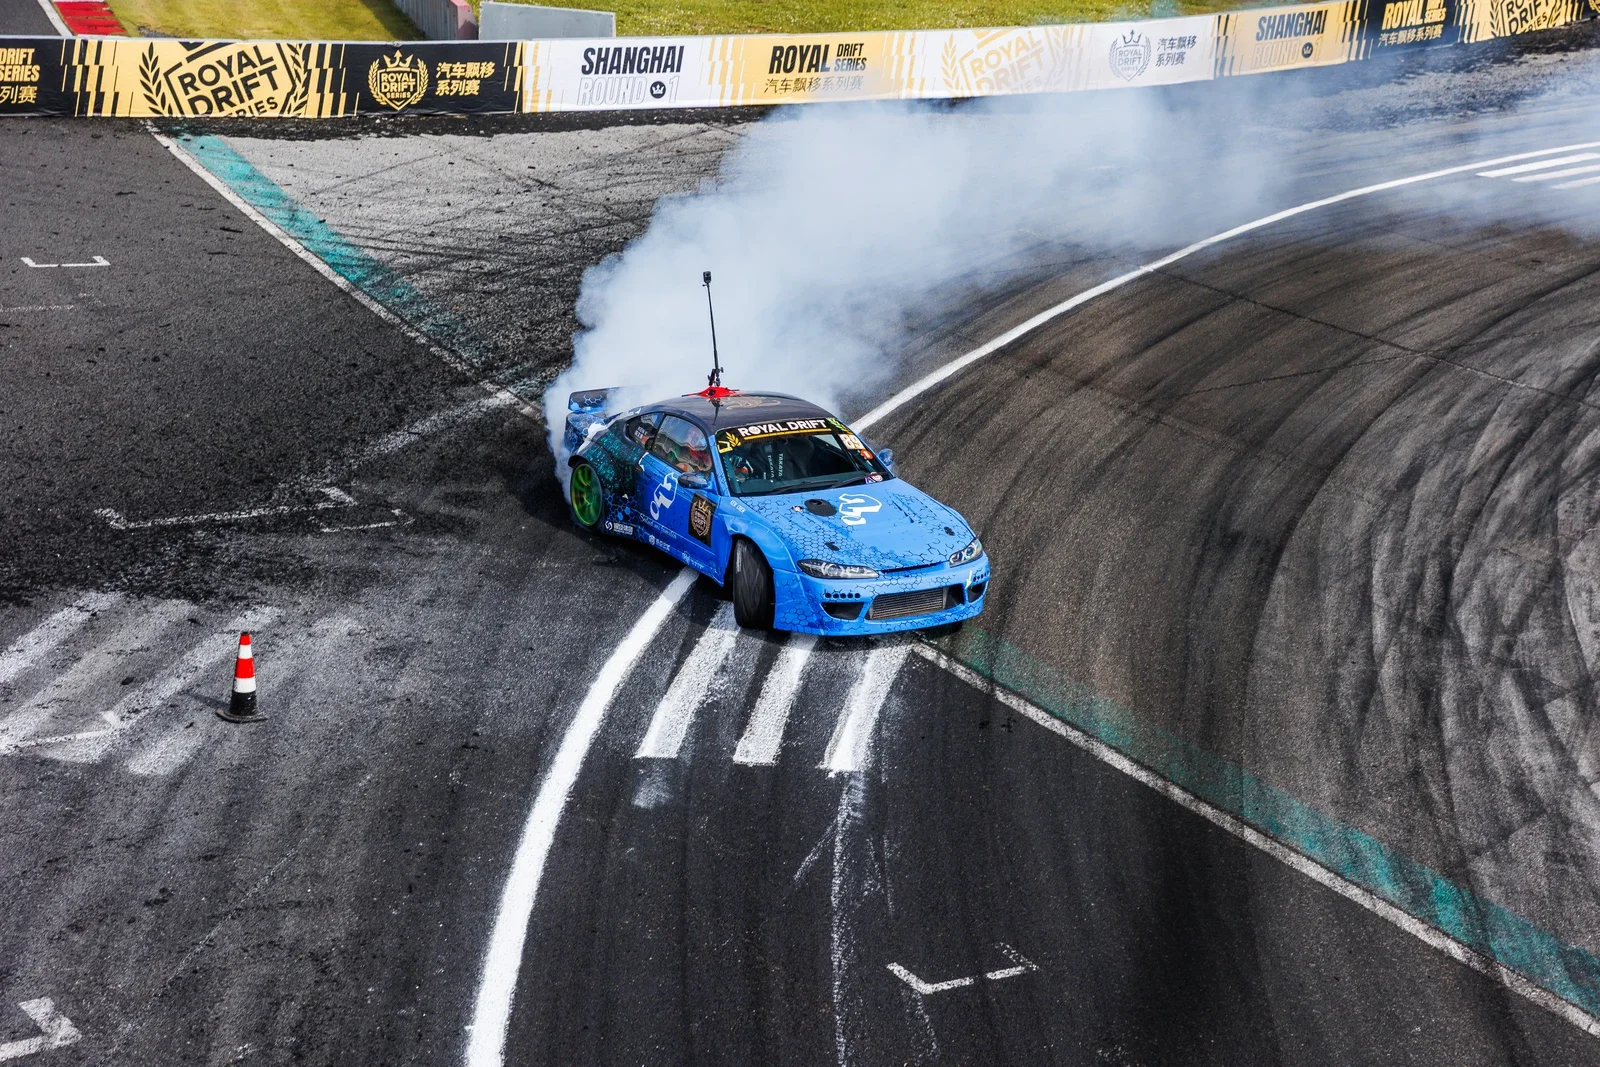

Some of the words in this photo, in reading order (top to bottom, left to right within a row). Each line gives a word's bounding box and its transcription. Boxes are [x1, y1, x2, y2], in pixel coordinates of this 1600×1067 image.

[1382, 0, 1424, 30] ROYAL
[1255, 9, 1328, 42] SHANGHAI
[836, 43, 865, 57] DRIFT
[1157, 35, 1197, 51] 汽车飘移
[581, 45, 685, 75] SHANGHAI
[768, 44, 830, 74] ROYAL
[970, 30, 1042, 78] ROYAL
[1118, 49, 1142, 58] ROYAL
[1155, 52, 1186, 67] 系列赛
[1251, 39, 1300, 69] ROUND
[1313, 36, 1324, 63] 1
[177, 45, 275, 96] ROYAL
[435, 61, 496, 79] 汽车飘移
[834, 57, 867, 72] SERIES
[975, 46, 1045, 95] DRIFT
[1117, 57, 1142, 67] DRIFT
[381, 73, 416, 82] ROYAL
[764, 75, 864, 94] 汽车飘移系列赛
[187, 63, 279, 117] DRIFT
[381, 82, 416, 93] DRIFT
[435, 79, 481, 96] 系列赛
[577, 76, 648, 106] ROUND
[668, 75, 680, 104] 1
[737, 422, 788, 437] ROYAL
[786, 419, 827, 431] DRIFT
